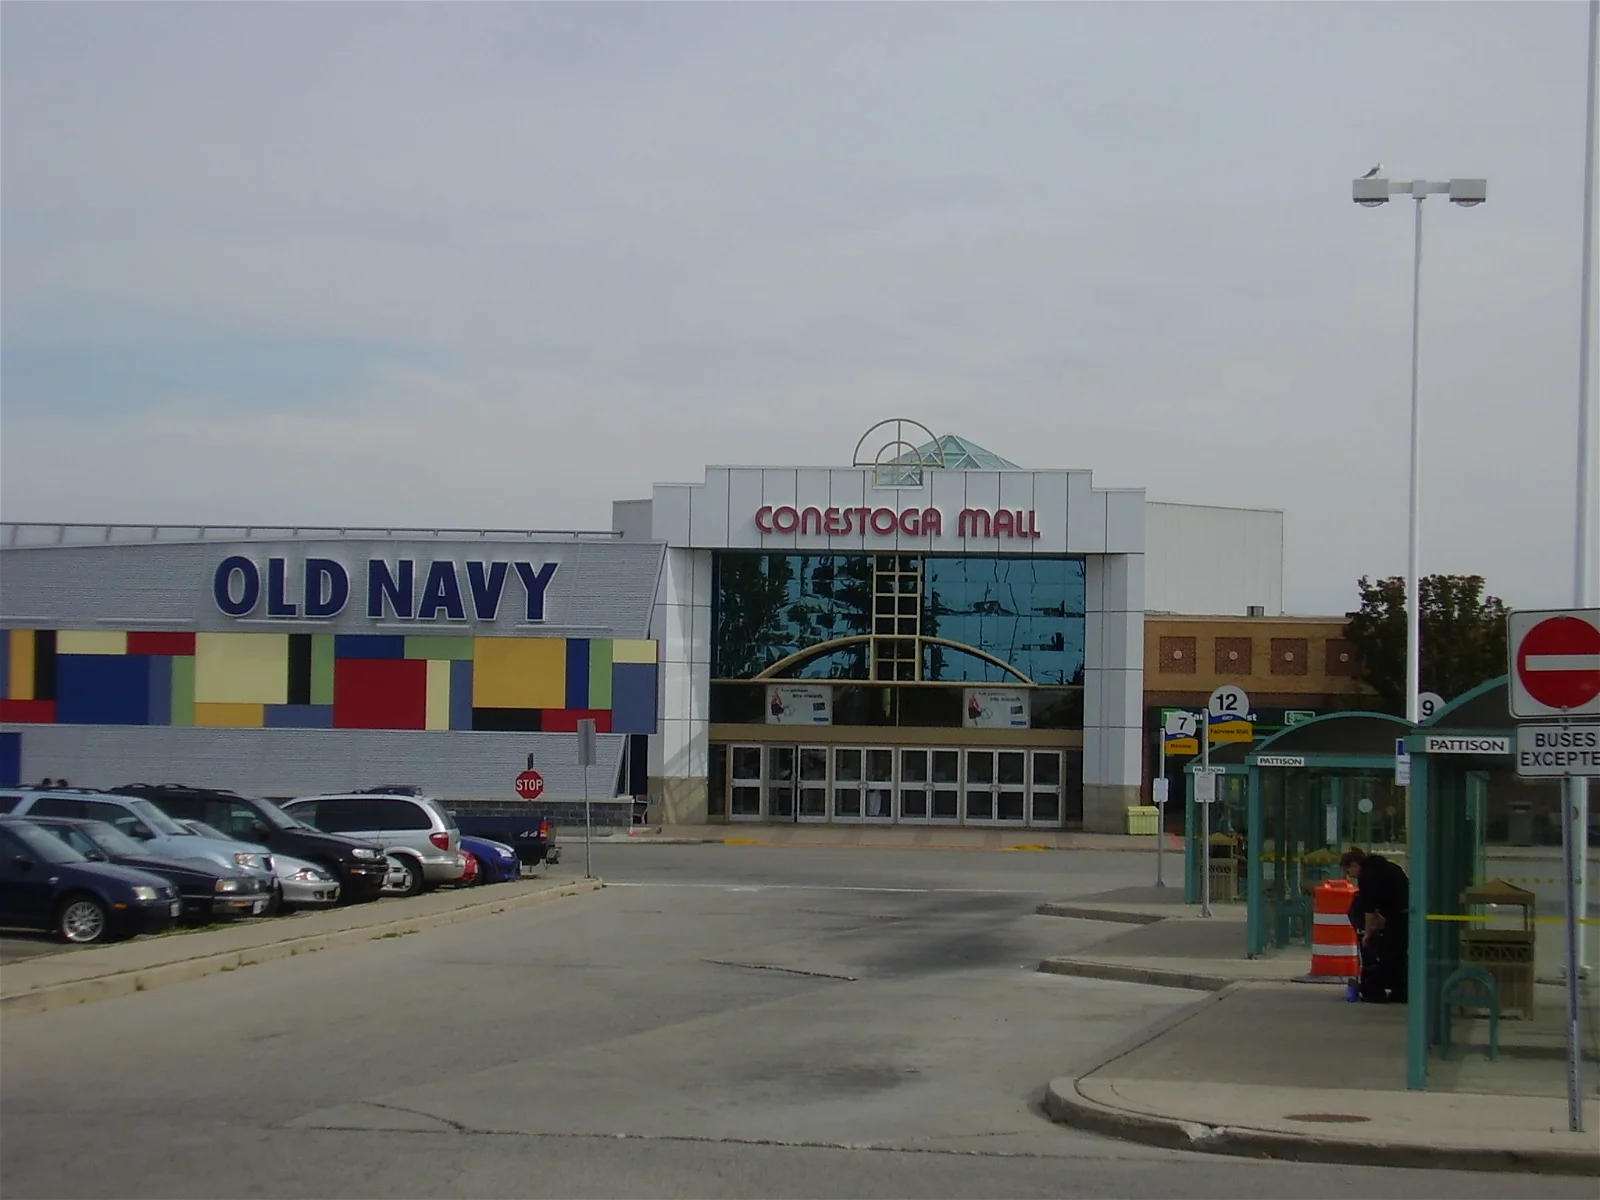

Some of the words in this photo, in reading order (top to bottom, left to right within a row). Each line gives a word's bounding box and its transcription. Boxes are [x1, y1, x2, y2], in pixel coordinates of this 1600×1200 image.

[755, 505, 942, 537] CONESTOGA
[958, 508, 1041, 539] MALL
[213, 555, 350, 618] OLD
[365, 558, 560, 622] NAVY
[1216, 693, 1238, 711] 12
[1422, 699, 1434, 717] 9
[1177, 717, 1188, 731] 7
[1429, 738, 1505, 752] PATTISON
[1535, 732, 1597, 748] BUSES
[1259, 757, 1302, 765] PATTISON
[516, 779, 543, 792] STOP
